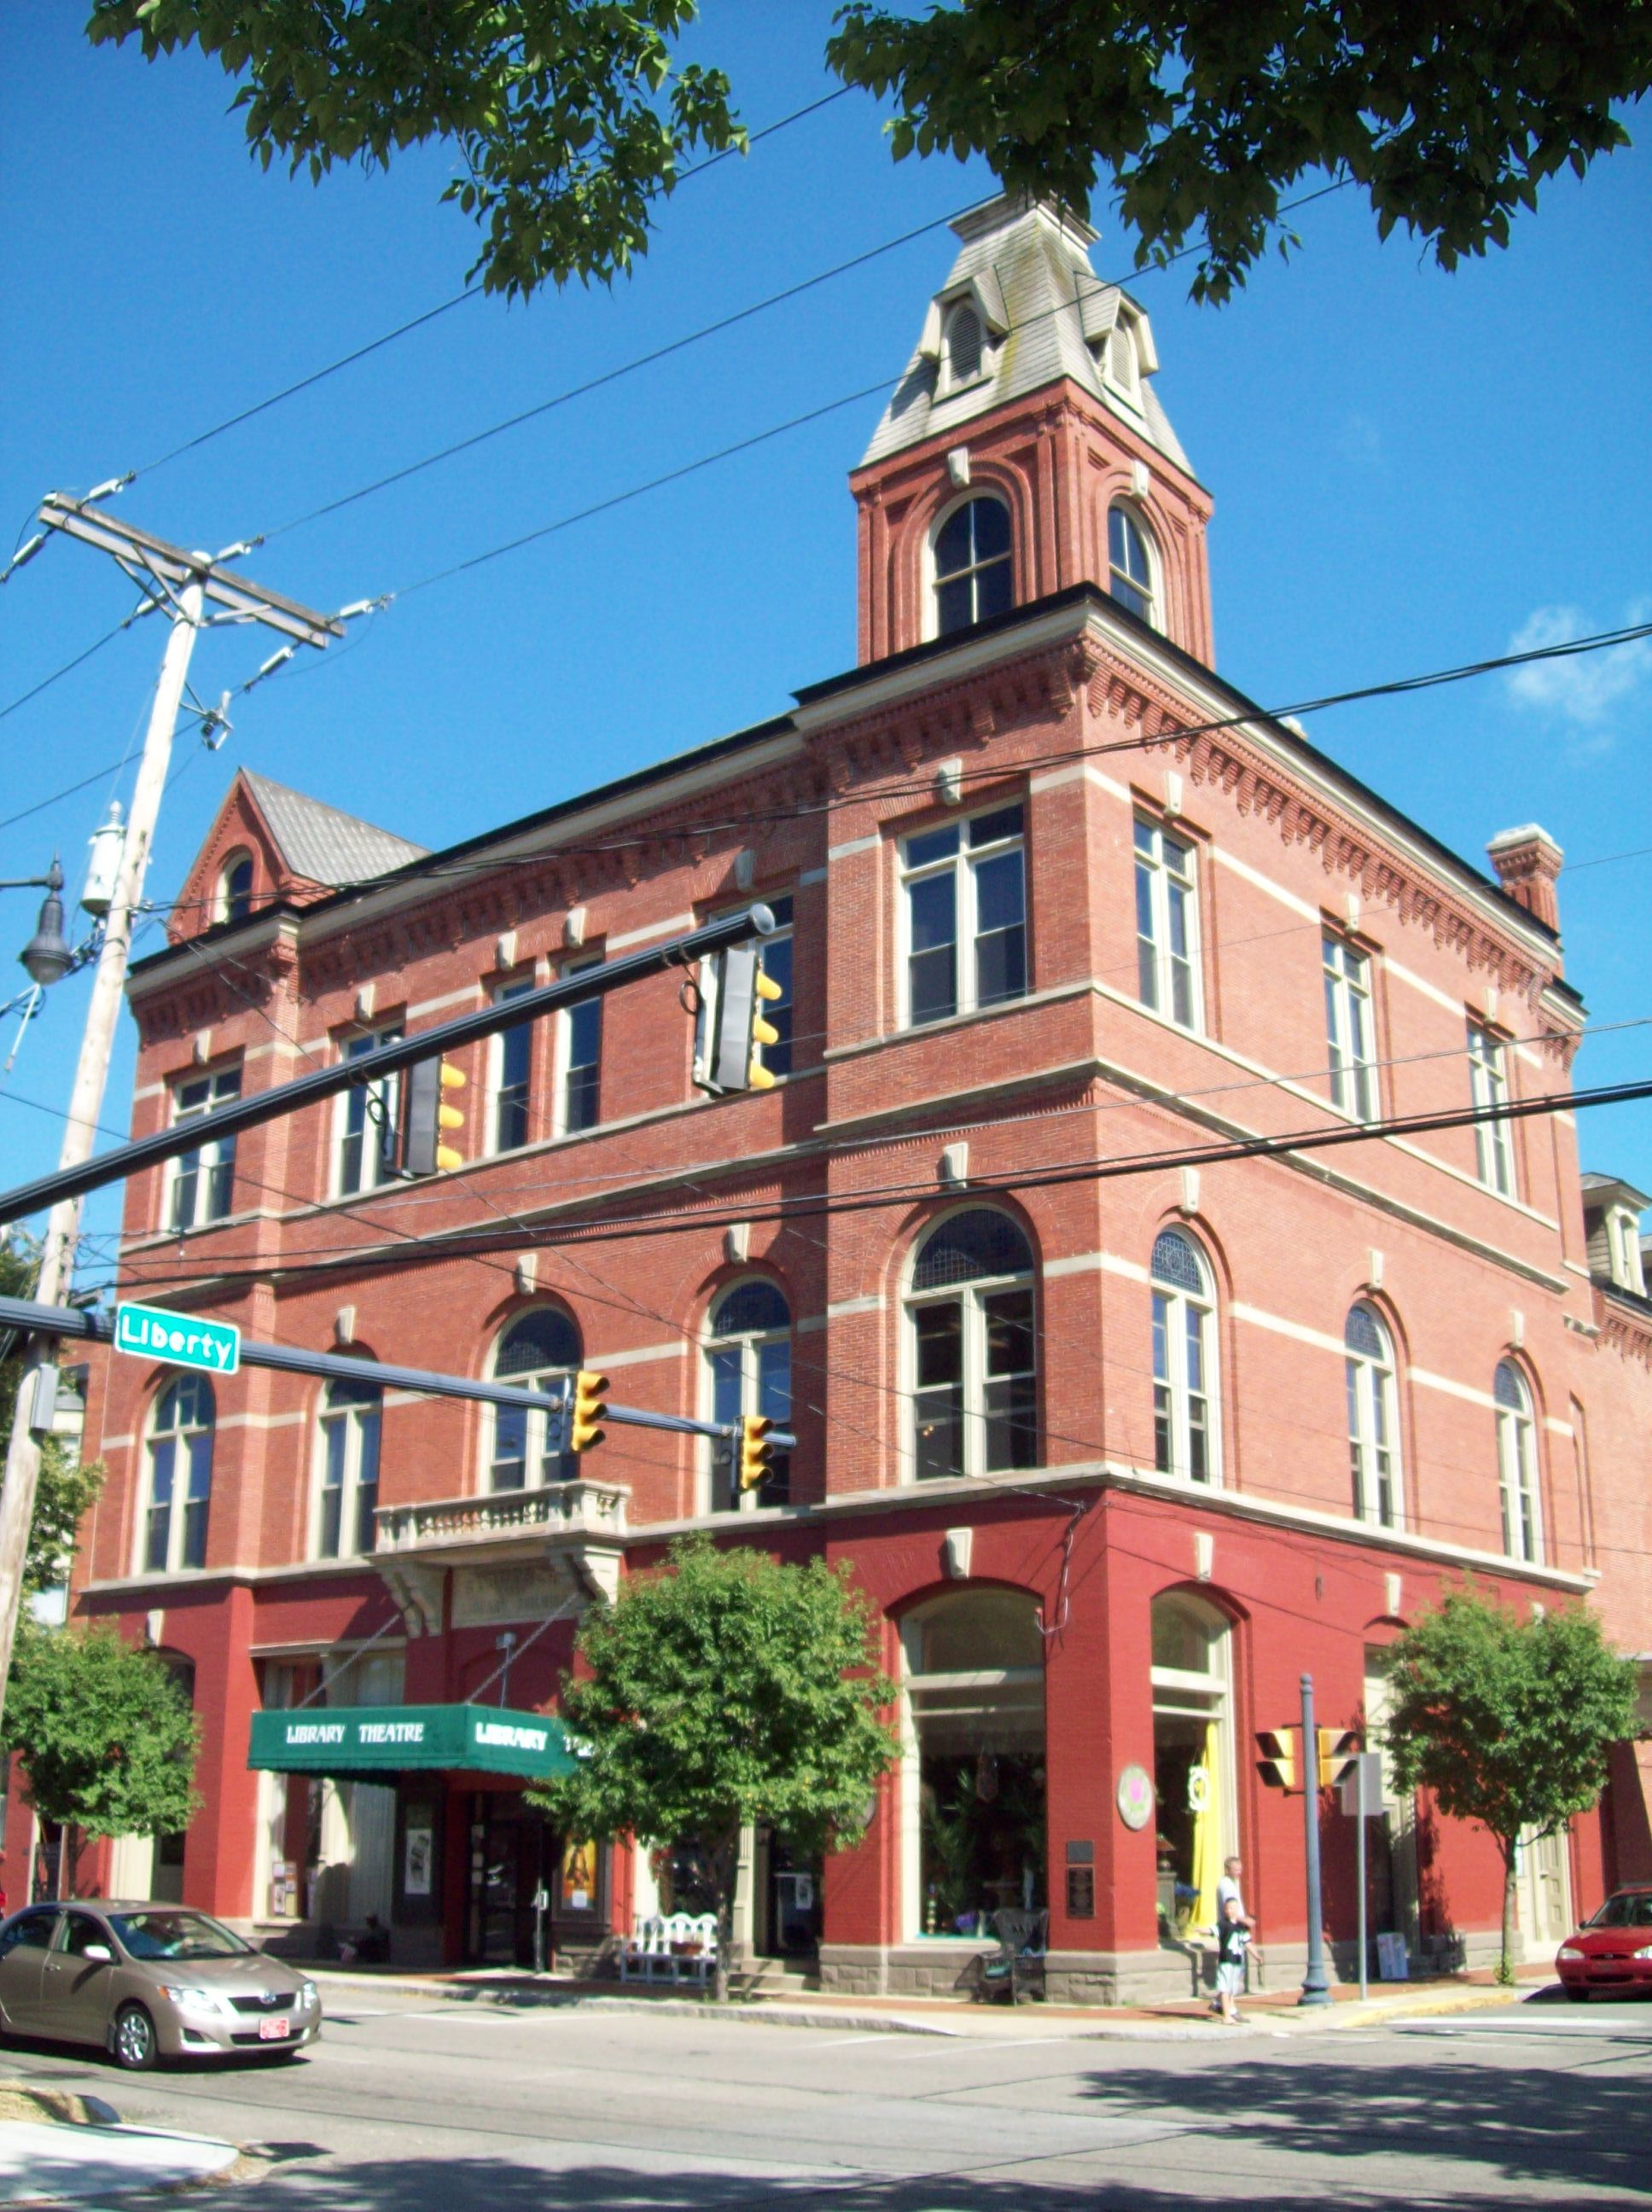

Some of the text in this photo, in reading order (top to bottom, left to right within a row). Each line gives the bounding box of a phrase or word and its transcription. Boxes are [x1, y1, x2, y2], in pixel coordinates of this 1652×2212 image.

[121, 1314, 233, 1369] Liberty
[286, 1723, 424, 1743] LIBRARY THEATRE
[475, 1721, 548, 1750] LIBRARY
